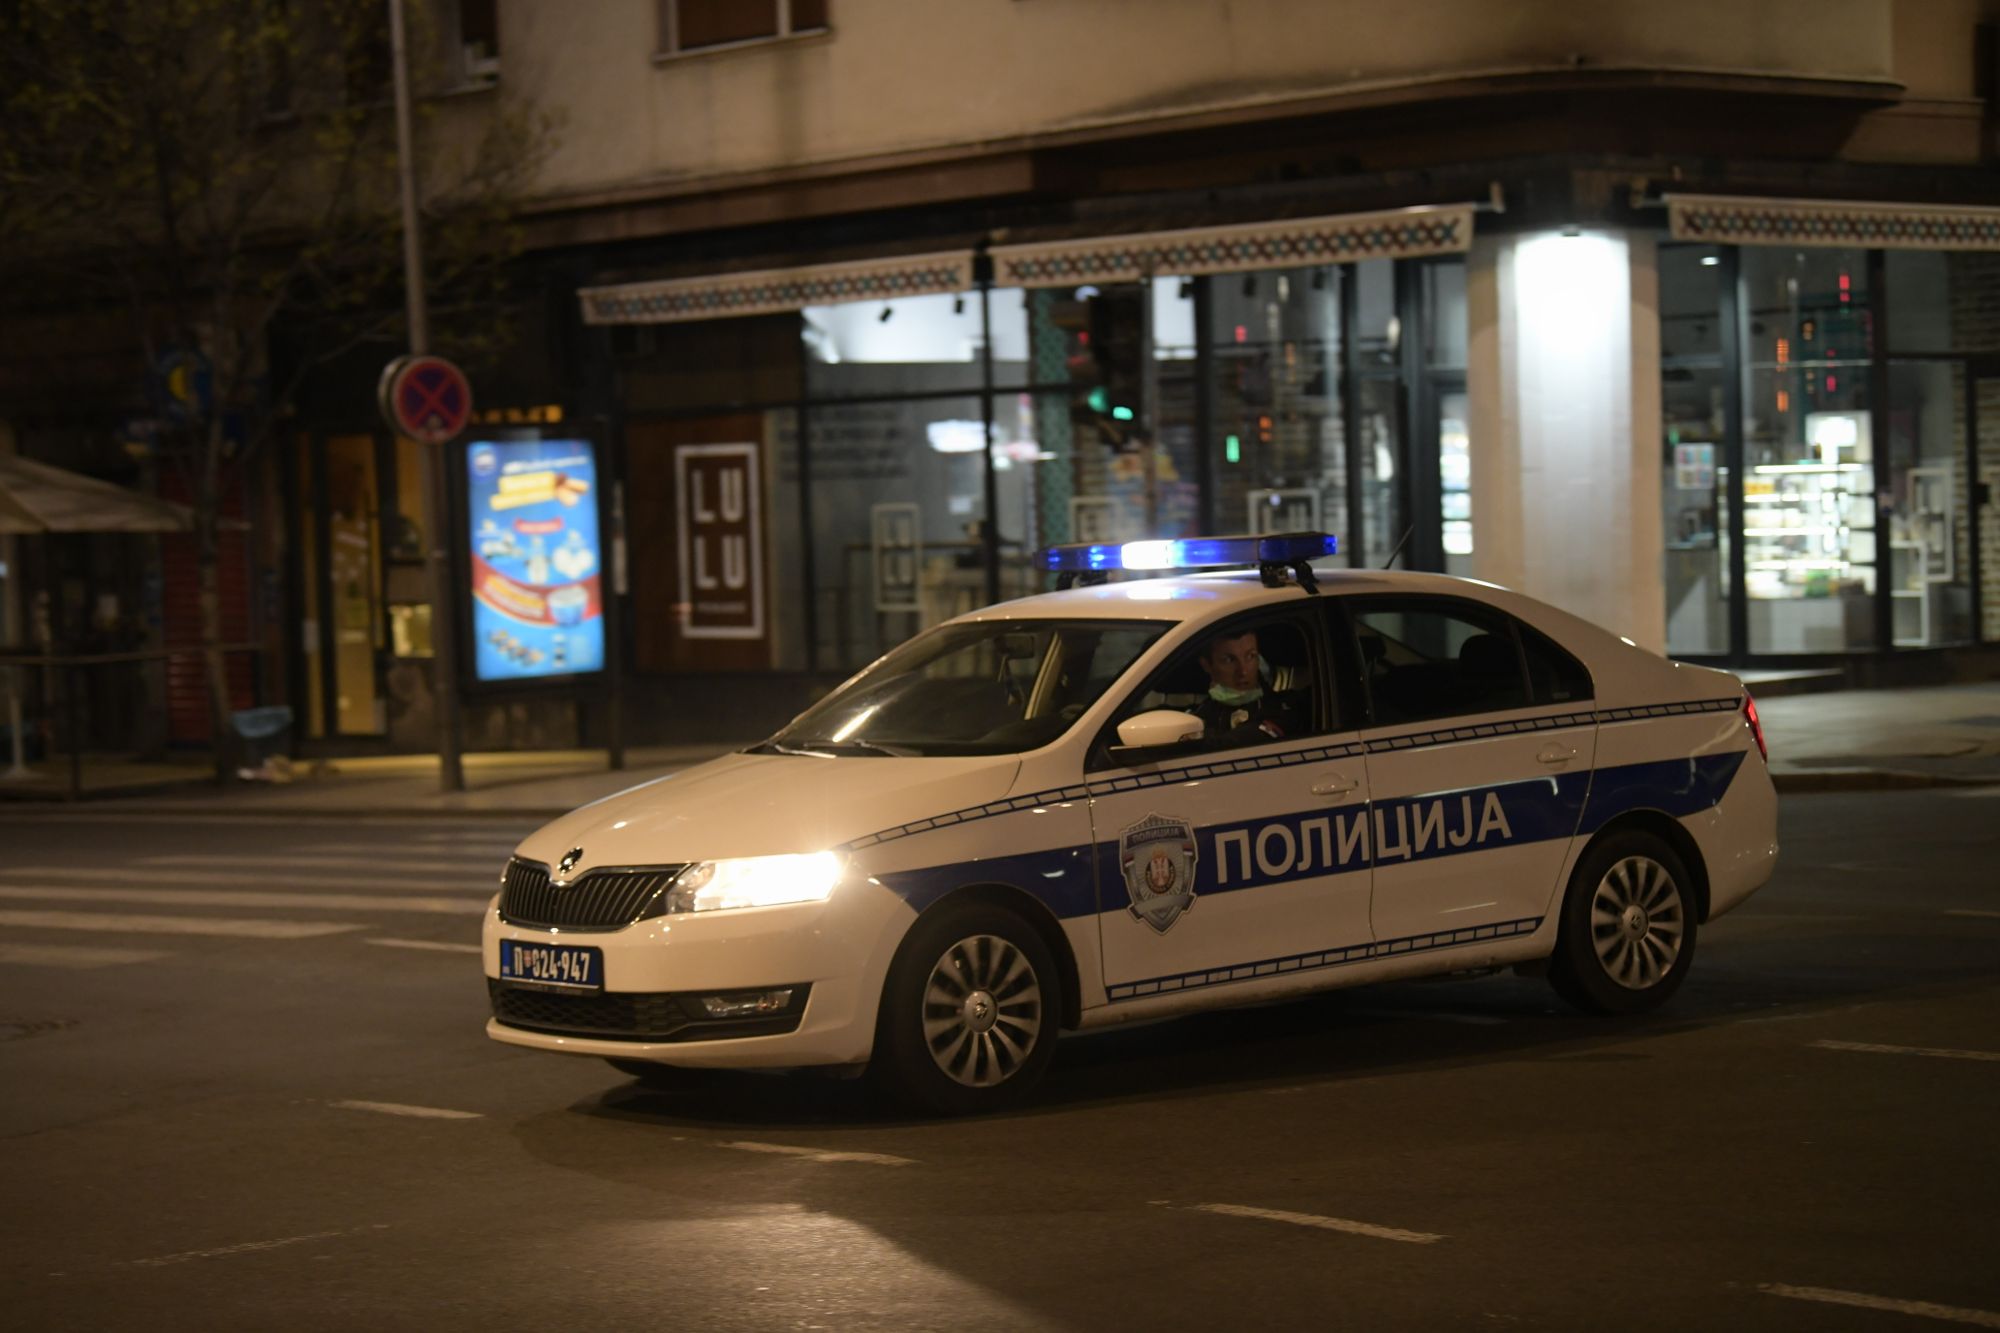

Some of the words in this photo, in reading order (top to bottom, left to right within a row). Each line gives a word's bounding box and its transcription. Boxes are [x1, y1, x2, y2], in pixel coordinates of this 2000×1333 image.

[692, 469, 744, 523] LU
[694, 535, 746, 589] LU
[1214, 791, 1513, 884] ПОЛИЦИЈА
